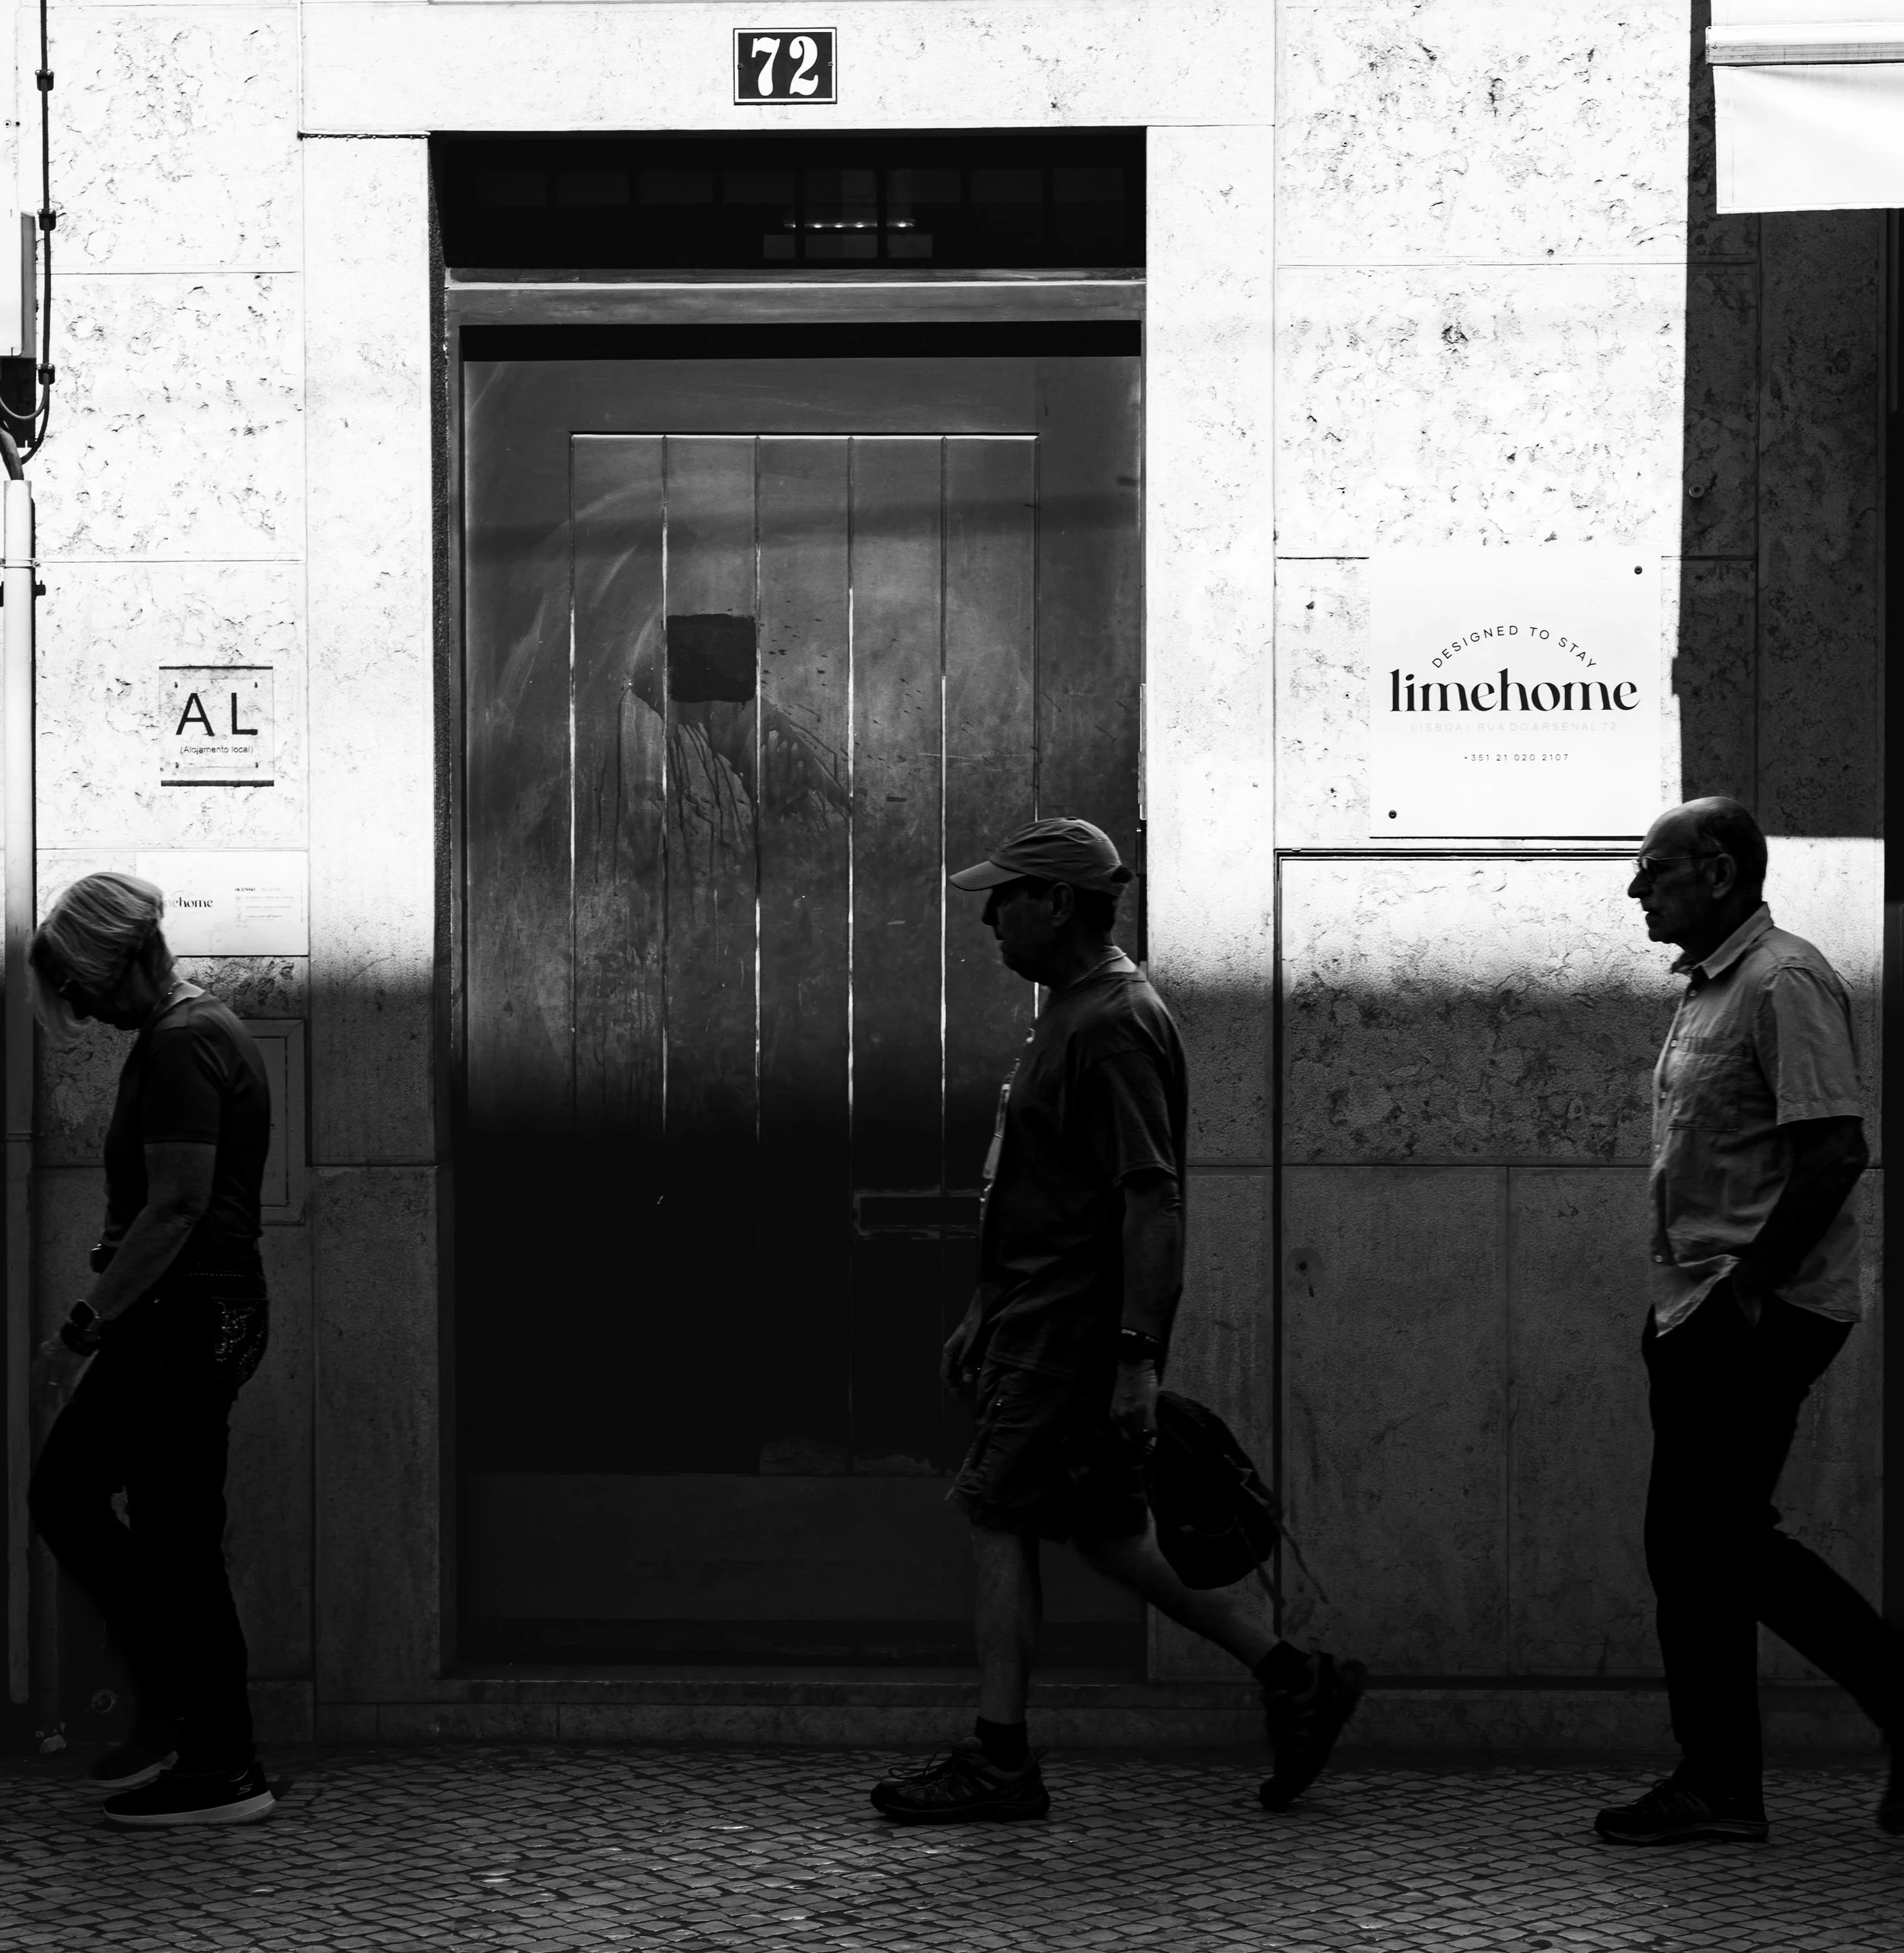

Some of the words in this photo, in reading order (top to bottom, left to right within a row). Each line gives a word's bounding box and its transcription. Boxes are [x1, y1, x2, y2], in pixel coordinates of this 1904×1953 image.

[751, 35, 819, 96] 72
[1432, 625, 1519, 669] DESIGNED
[1529, 627, 1550, 640] TO
[1558, 637, 1597, 669] STAY
[1389, 668, 1640, 711] limehome
[1411, 723, 1463, 731] LISBOA
[1478, 723, 1505, 731] RUA
[1510, 723, 1528, 731] DO
[1532, 723, 1596, 731] ARSENAL
[1602, 722, 1617, 731] 72
[180, 746, 228, 755] (Alojamento
